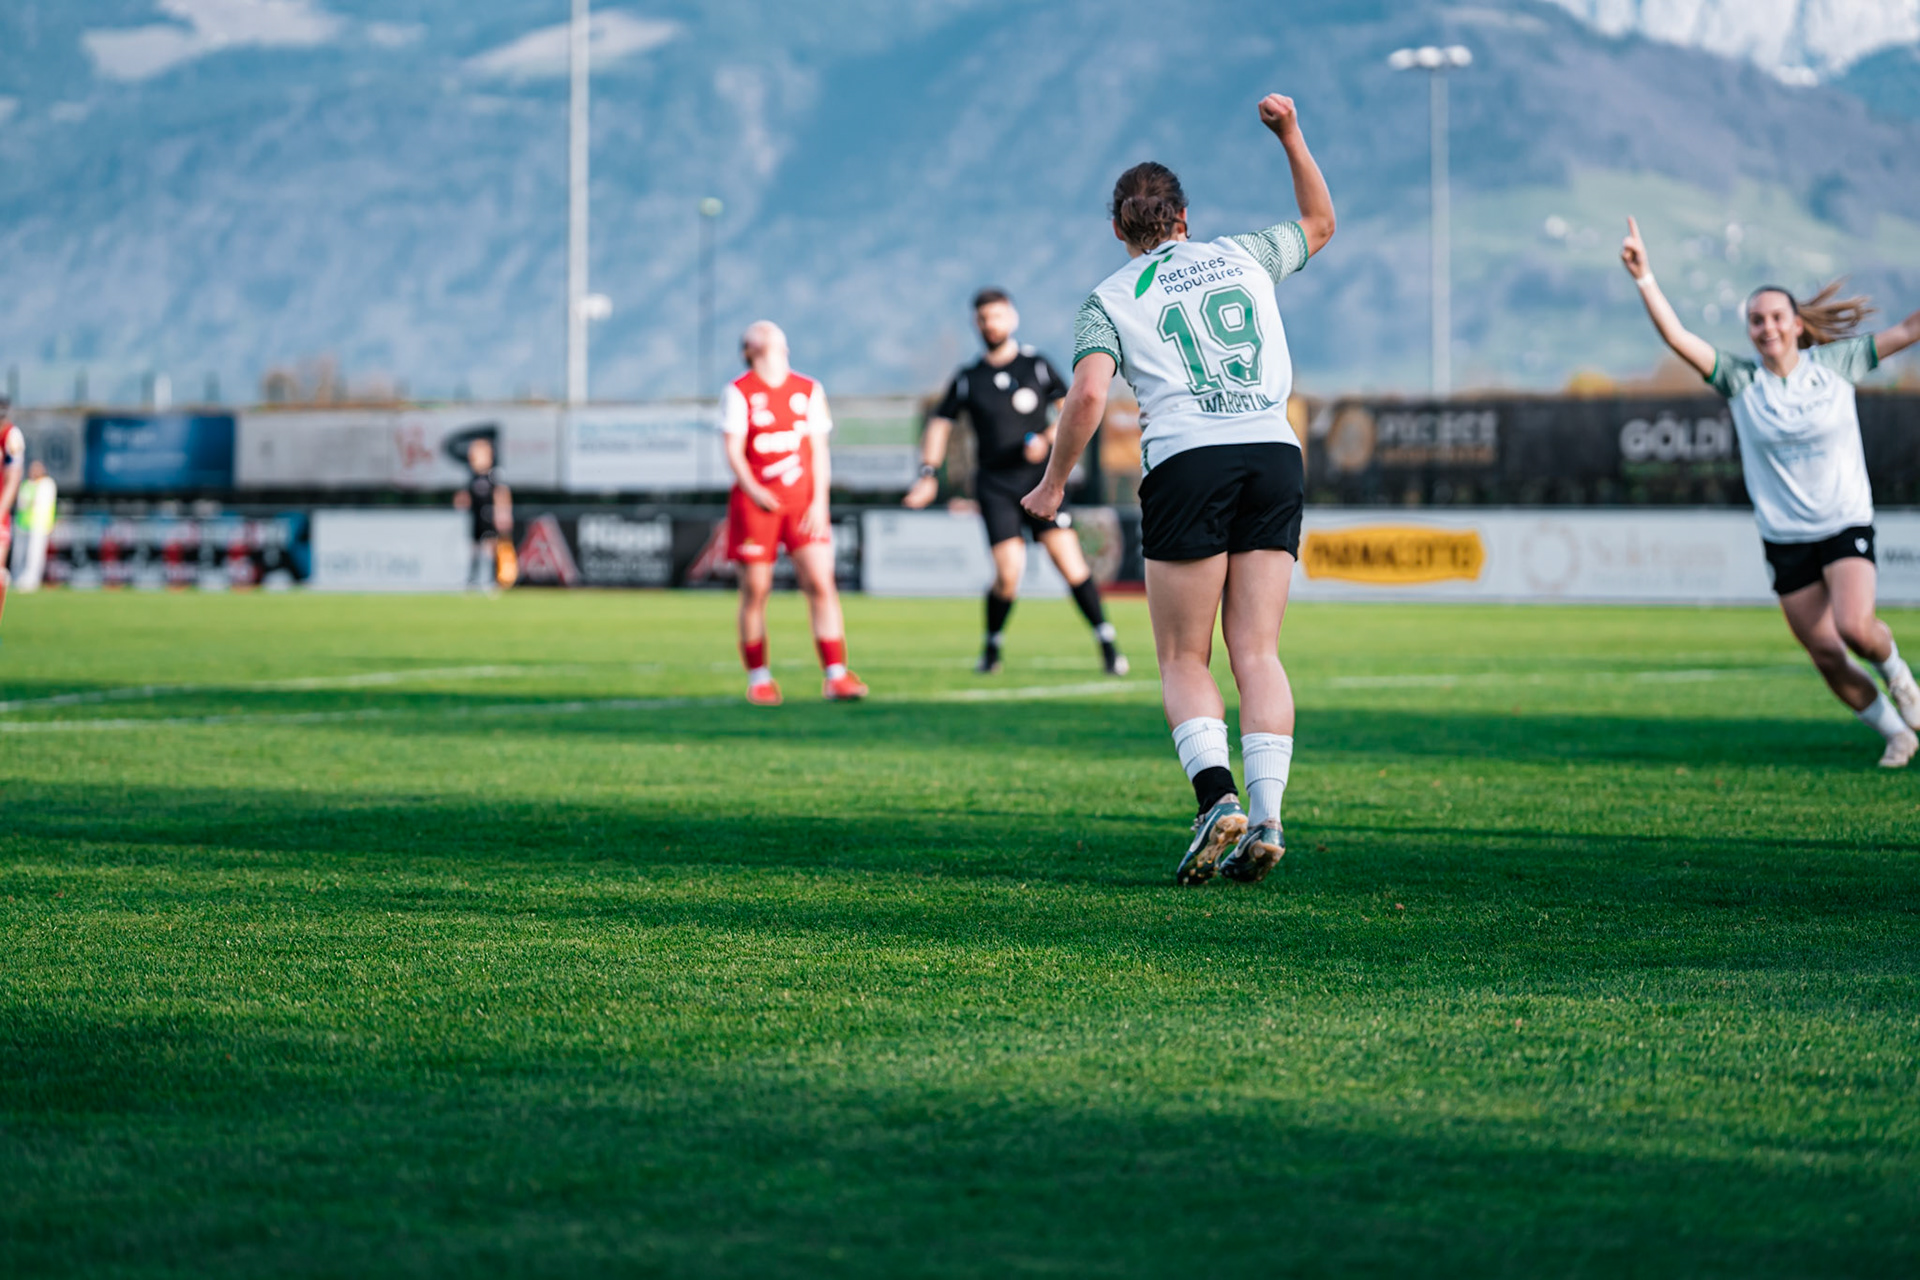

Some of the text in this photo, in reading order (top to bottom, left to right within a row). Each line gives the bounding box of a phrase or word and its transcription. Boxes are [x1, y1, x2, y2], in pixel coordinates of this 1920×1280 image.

[1157, 256, 1226, 286] Retraites
[1163, 266, 1243, 294] Populaires
[1157, 284, 1264, 395] 19
